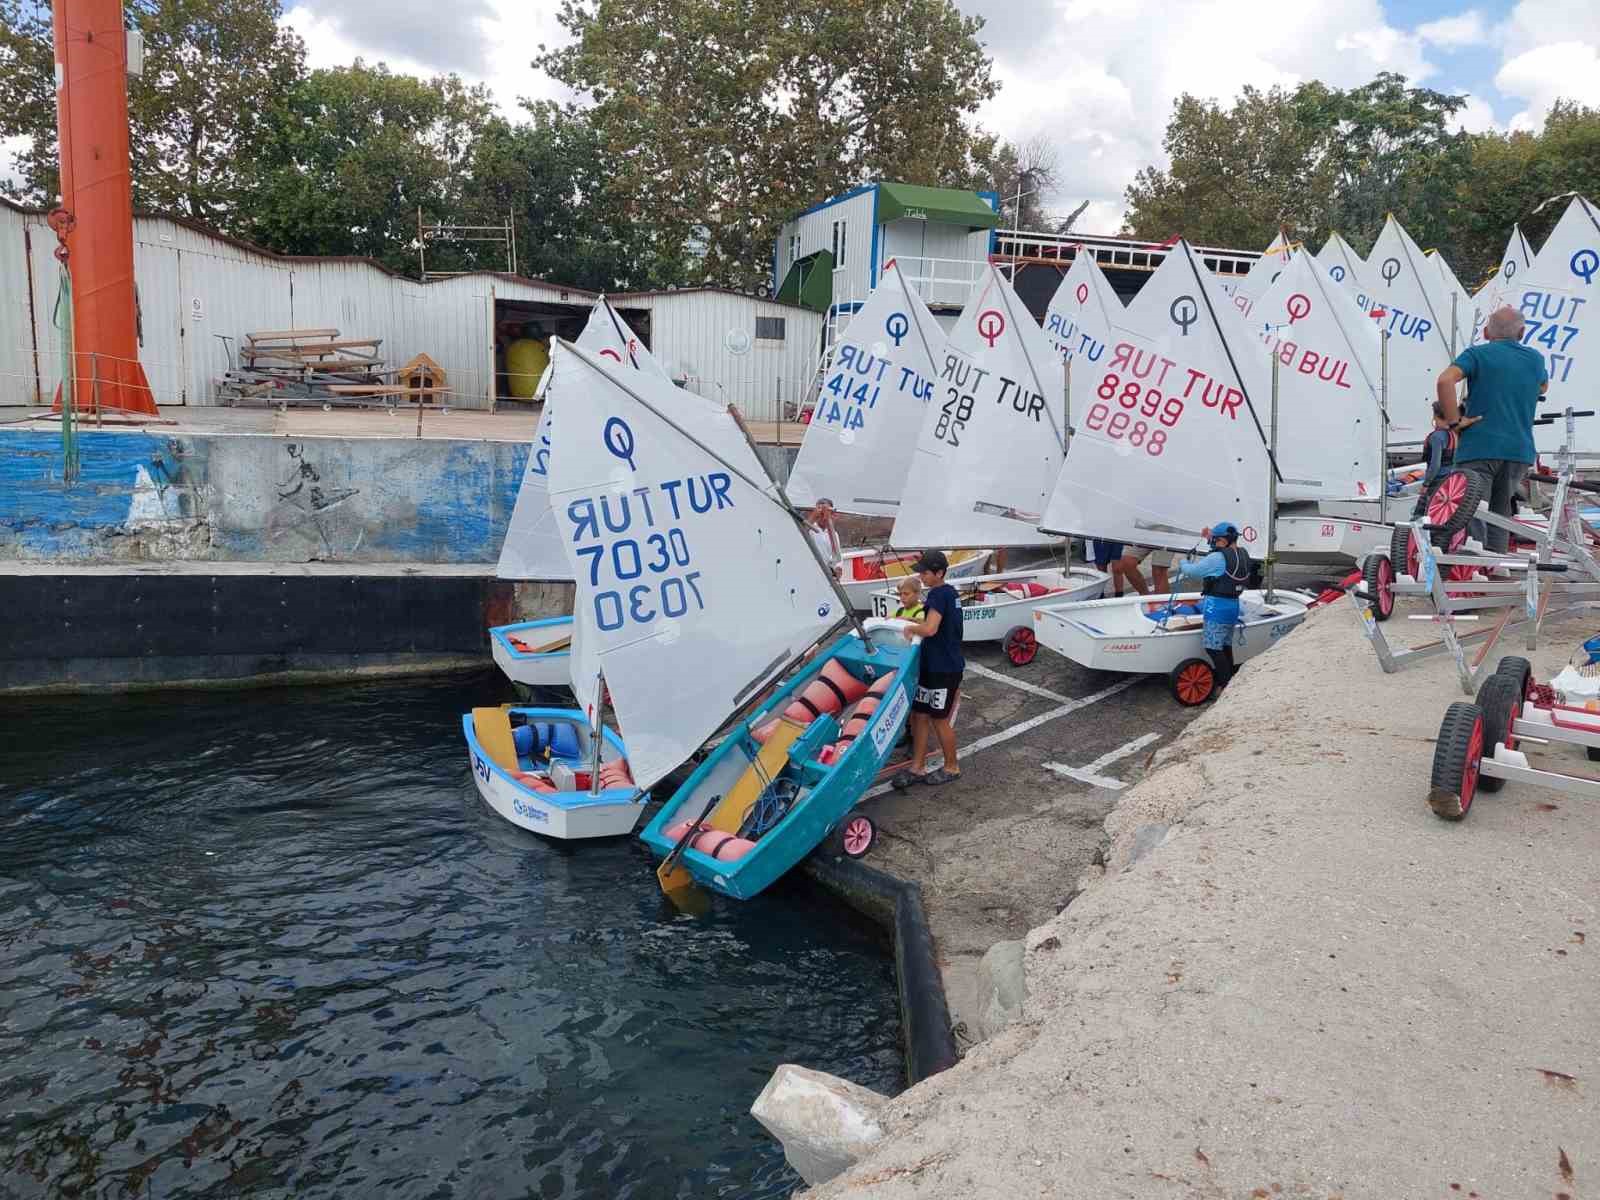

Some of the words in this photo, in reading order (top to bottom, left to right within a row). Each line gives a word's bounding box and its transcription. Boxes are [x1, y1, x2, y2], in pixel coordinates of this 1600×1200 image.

[1389, 308, 1432, 342] TUR
[1524, 320, 1579, 352] 747
[1079, 333, 1104, 361] TU
[1298, 350, 1351, 388] BUL
[827, 373, 880, 409] 4141
[942, 388, 974, 421] 28
[996, 377, 1044, 422] TUR
[1097, 373, 1184, 427] 8899
[1183, 368, 1244, 420] TUR
[660, 473, 735, 520] TUR
[576, 528, 690, 586] 7030
[873, 596, 888, 618] 15
